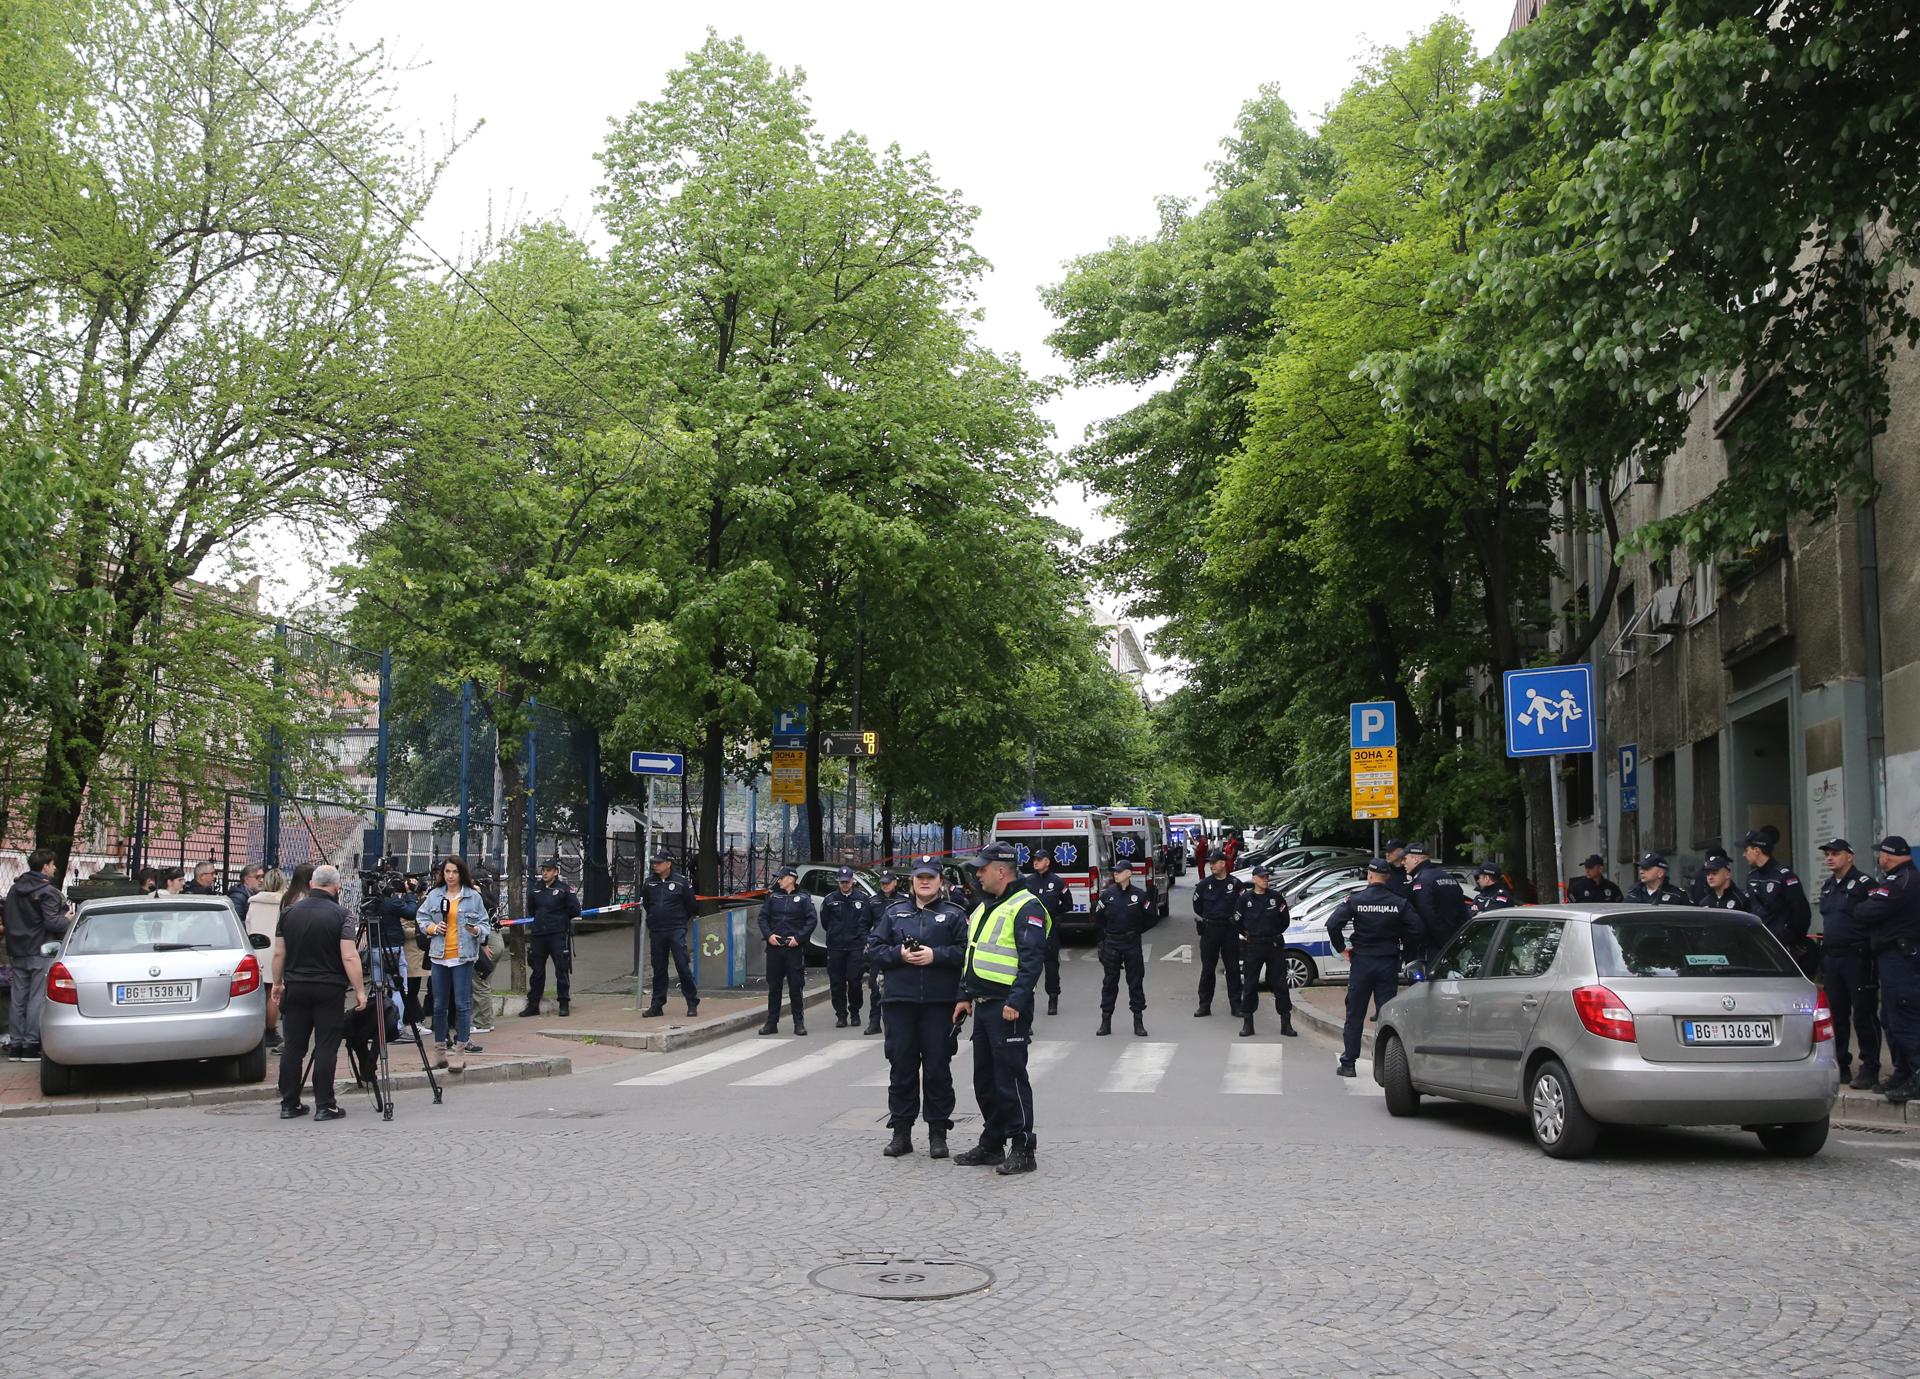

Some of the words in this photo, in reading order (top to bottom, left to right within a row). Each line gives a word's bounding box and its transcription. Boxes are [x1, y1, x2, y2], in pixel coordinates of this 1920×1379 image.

[1361, 709, 1385, 742] P
[1354, 751, 1383, 760] ЗОНА
[1387, 750, 1393, 758] 2
[1622, 750, 1634, 784] P
[1075, 819, 1084, 828] 12
[1357, 905, 1399, 913] ПОЛИЦИЈА
[126, 987, 139, 999] BG
[1695, 1024, 1711, 1039] BG
